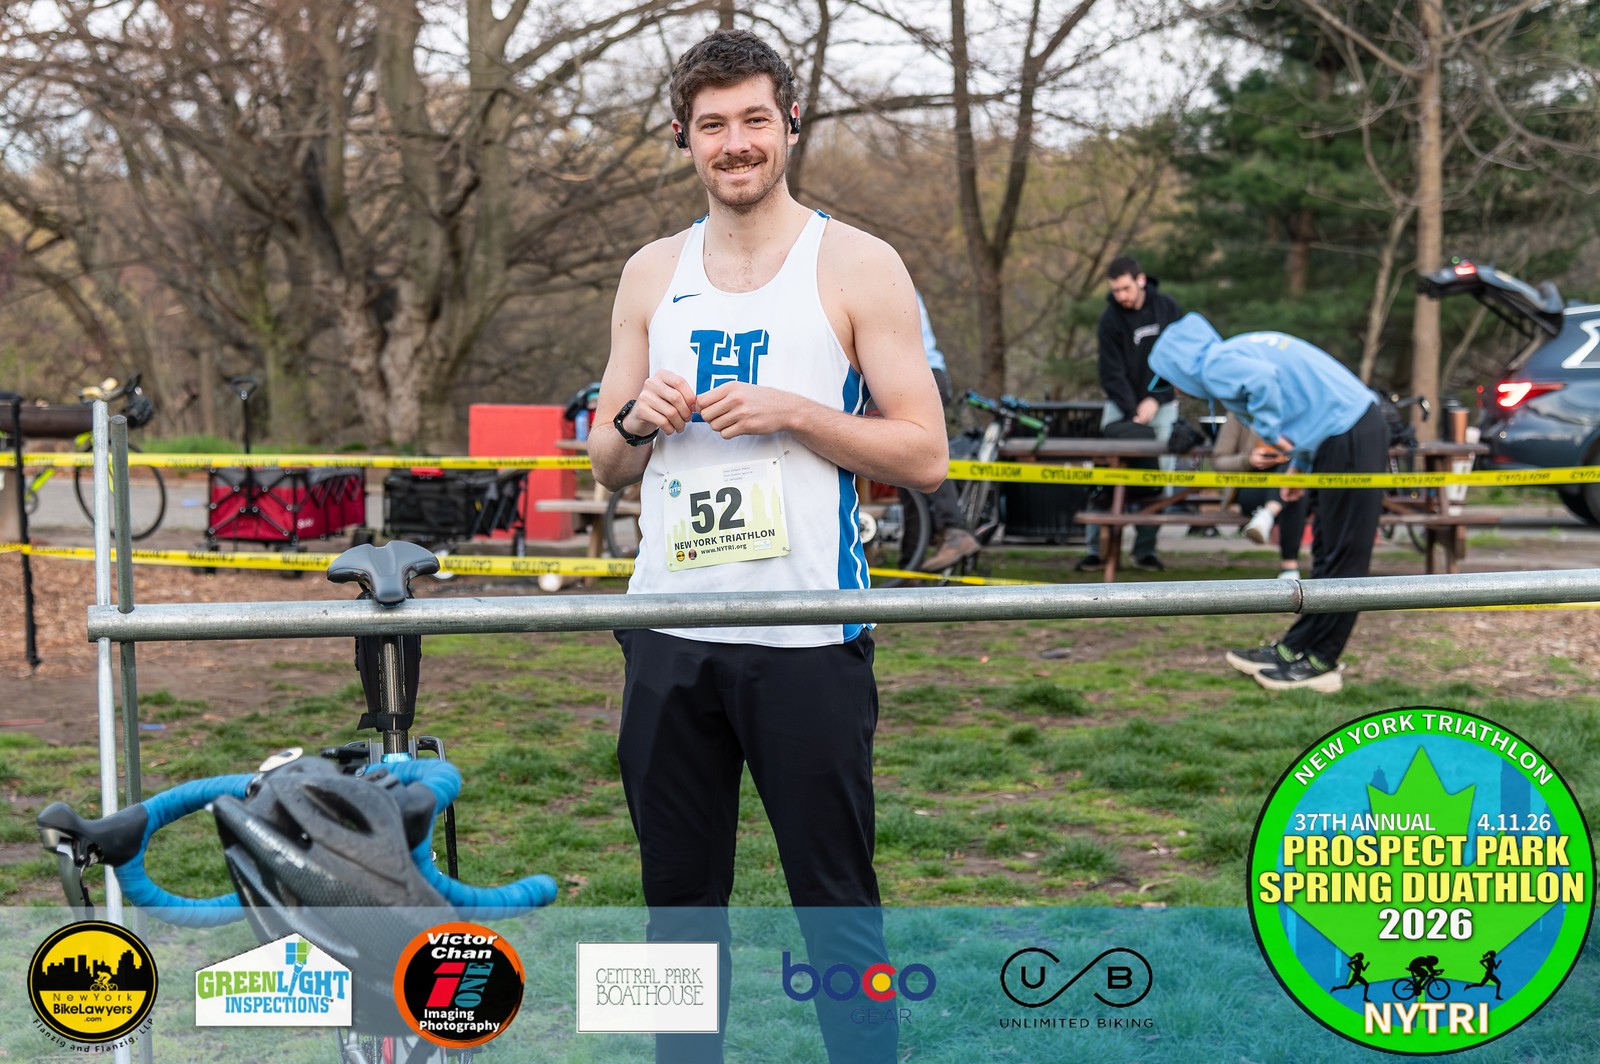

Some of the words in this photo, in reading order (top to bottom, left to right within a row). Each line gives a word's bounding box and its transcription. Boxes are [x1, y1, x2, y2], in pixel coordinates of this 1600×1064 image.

[690, 329, 769, 422] H
[690, 487, 745, 534] 52
[674, 539, 692, 551] NEW
[694, 536, 717, 547] YORK
[720, 528, 776, 543] TRIATHLON
[701, 543, 747, 555] www.NYTRI.org
[443, 558, 492, 573] CAUTION
[511, 560, 561, 574] CAUTION
